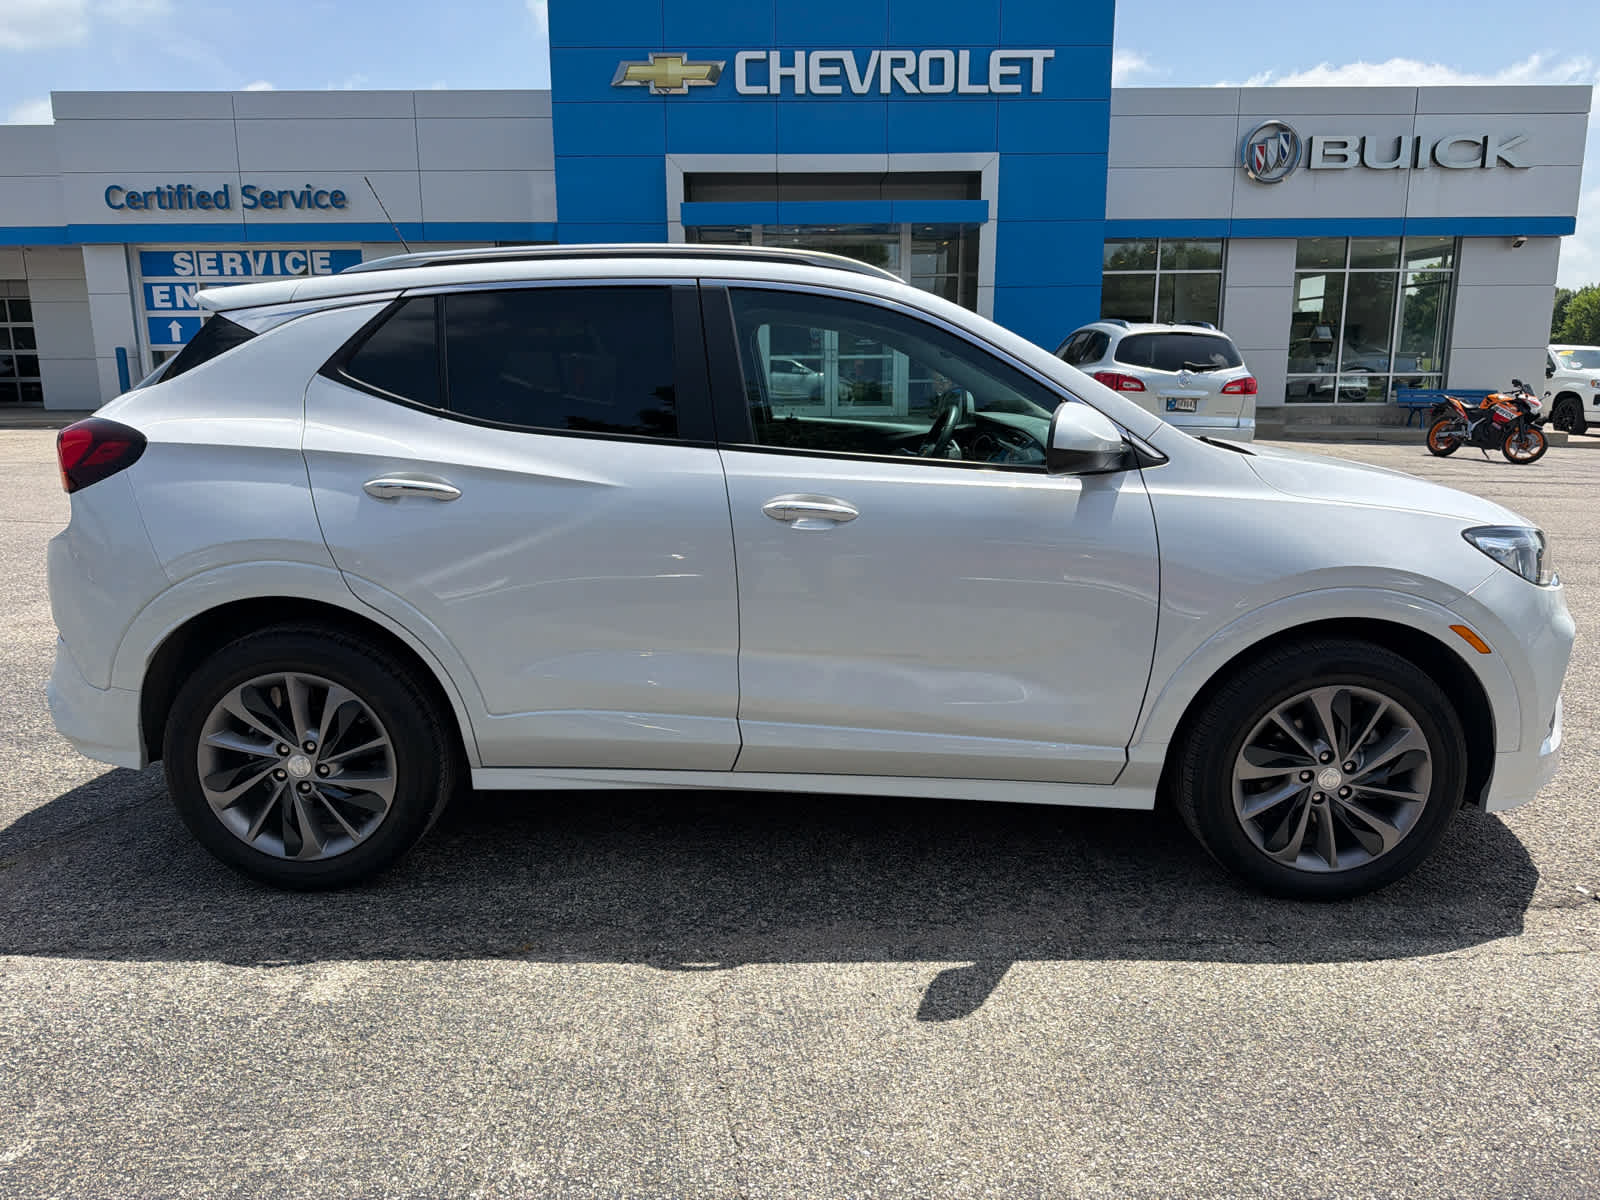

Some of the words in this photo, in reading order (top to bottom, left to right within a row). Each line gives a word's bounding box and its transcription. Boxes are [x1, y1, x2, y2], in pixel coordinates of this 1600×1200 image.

[734, 49, 1056, 95] CHEVROLET
[1309, 134, 1529, 170] BUICK
[104, 183, 231, 211] Certified
[241, 184, 347, 210] Service
[172, 251, 333, 276] SERVICE
[152, 285, 200, 308] EN
